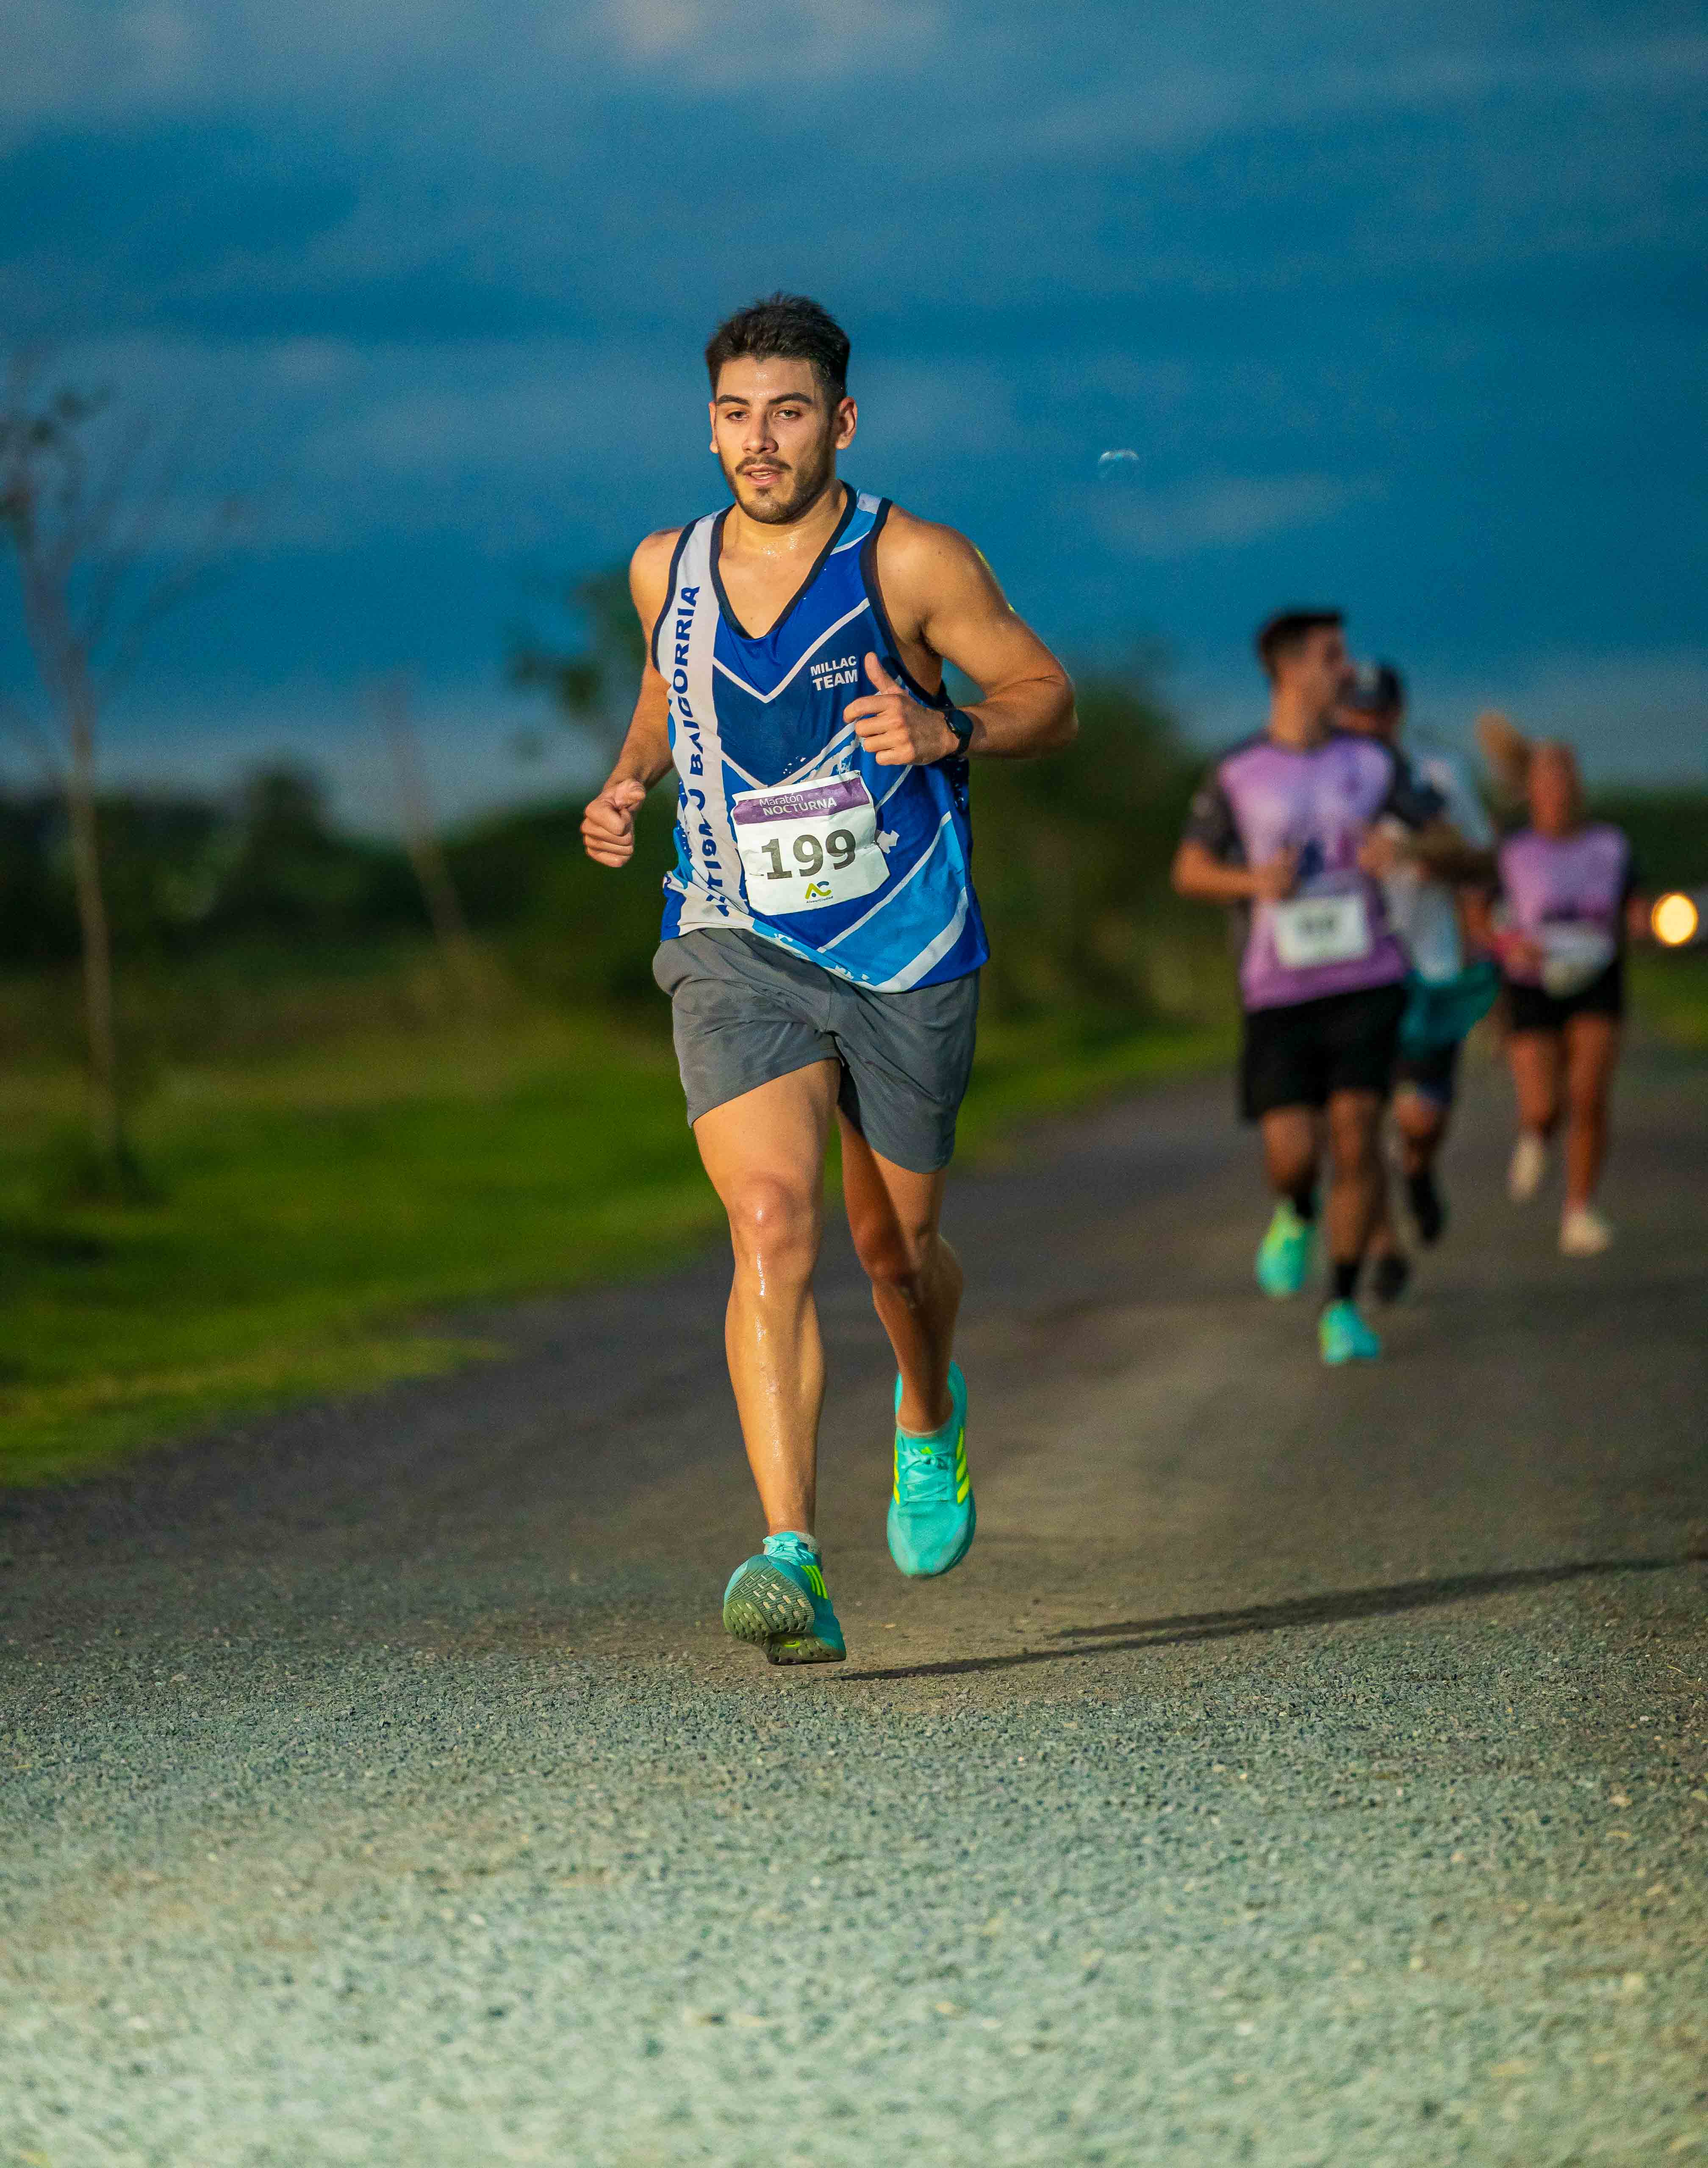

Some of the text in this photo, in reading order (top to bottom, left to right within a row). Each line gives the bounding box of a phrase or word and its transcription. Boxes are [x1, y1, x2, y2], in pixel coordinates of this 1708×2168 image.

[810, 656, 857, 676] MILLAC
[673, 586, 703, 776] BAIGORRIA
[812, 669, 858, 690] TEAM
[759, 793, 804, 807] Maratón
[762, 797, 837, 815] NOCTURNA
[761, 829, 856, 879] 199
